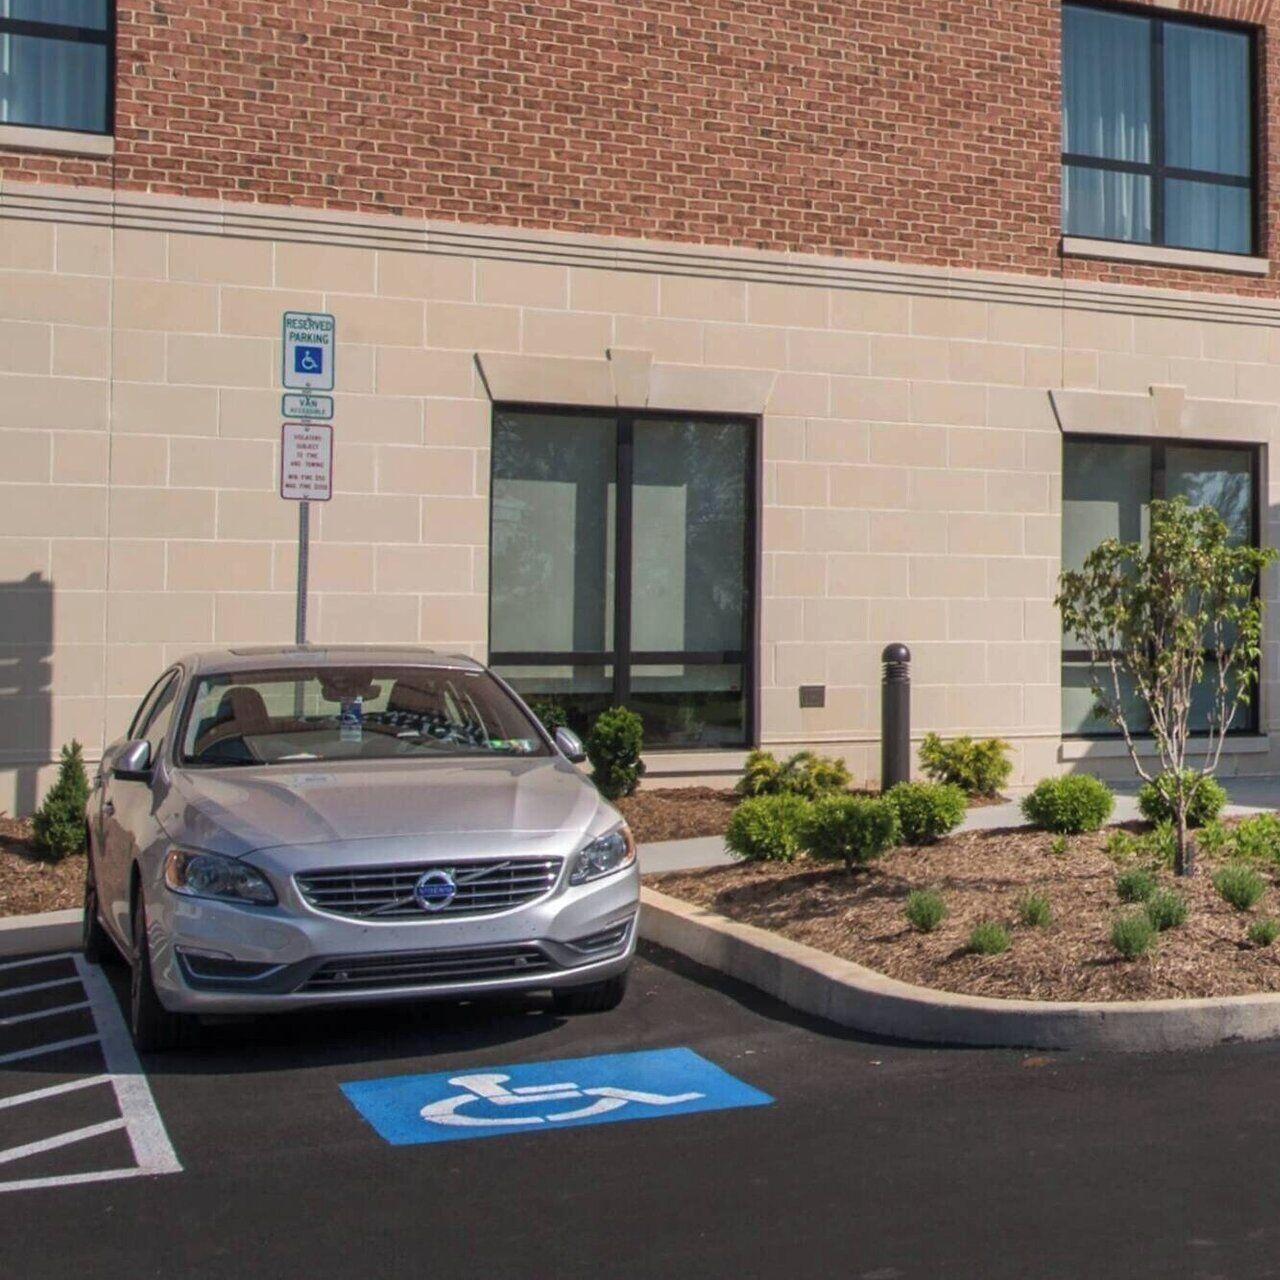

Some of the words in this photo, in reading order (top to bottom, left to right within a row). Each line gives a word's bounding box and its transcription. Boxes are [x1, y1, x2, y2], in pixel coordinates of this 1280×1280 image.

[286, 318, 332, 332] RESERVED
[289, 331, 330, 345] PARKING
[299, 398, 318, 408] VAN
